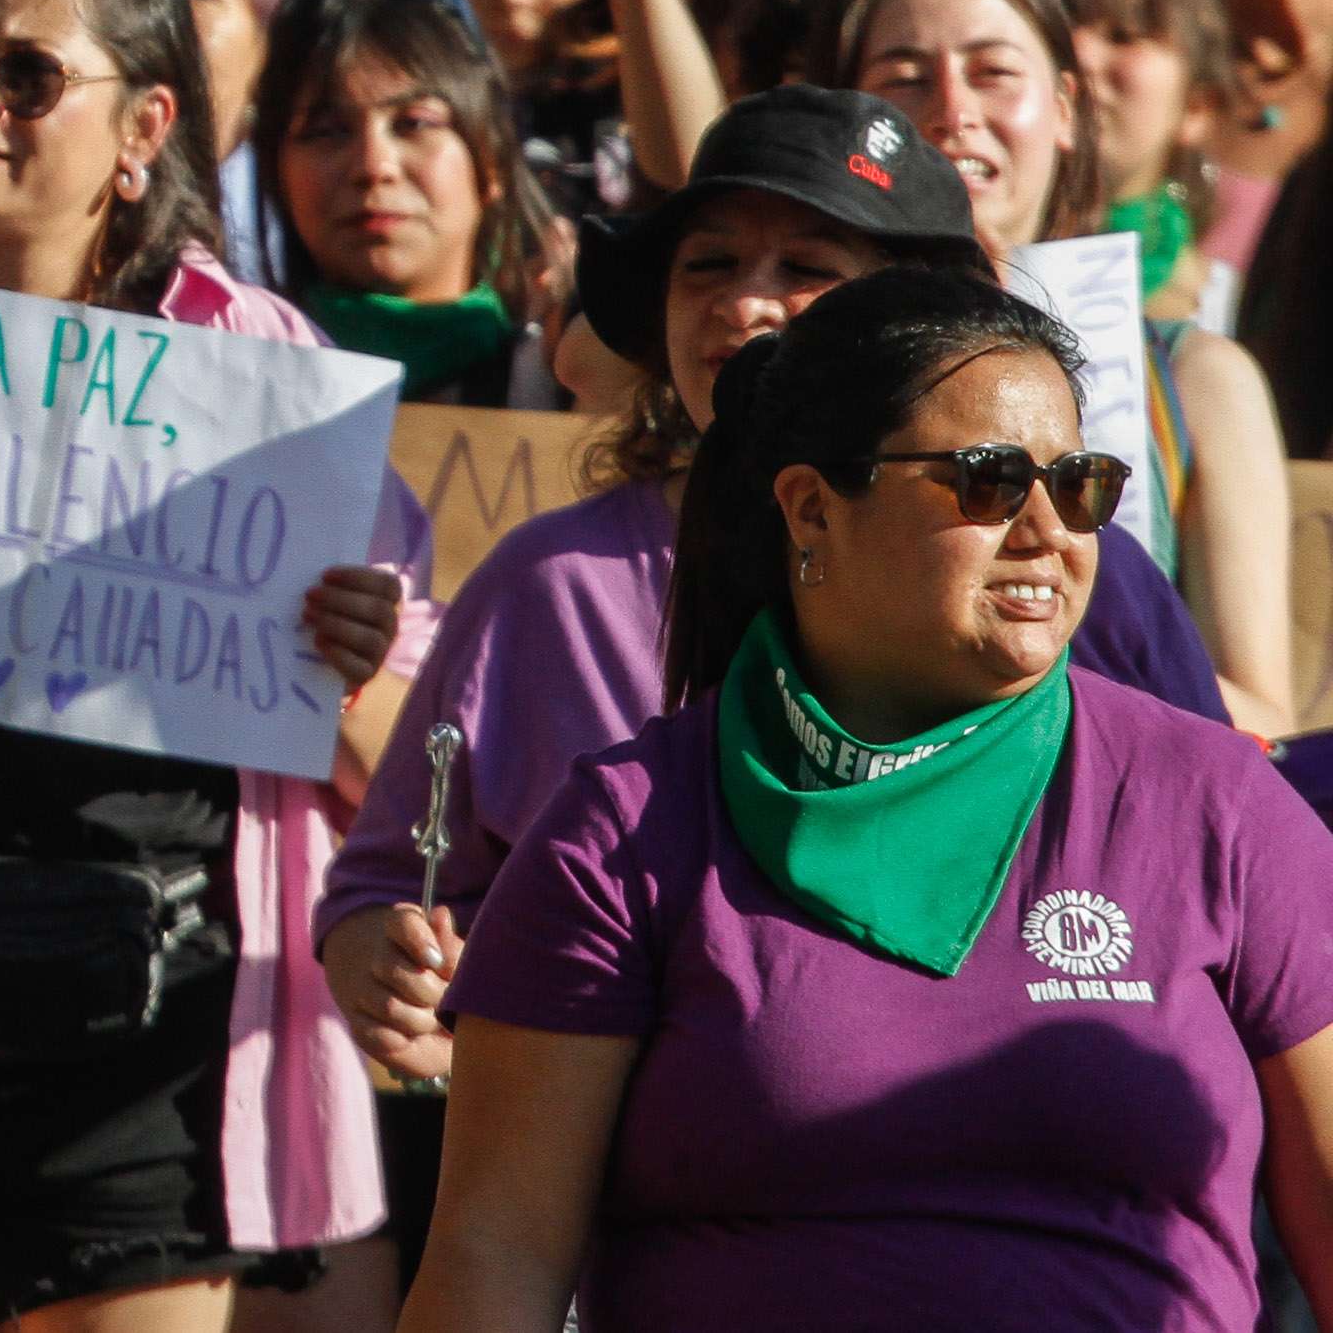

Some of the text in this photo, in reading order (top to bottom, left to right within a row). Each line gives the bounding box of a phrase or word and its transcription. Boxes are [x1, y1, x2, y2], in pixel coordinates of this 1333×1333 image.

[848, 153, 892, 192] Cuba
[42, 316, 178, 448] PAZ,
[1059, 913, 1101, 952] 8M
[1025, 978, 1156, 1003] VIÑA DEL MAR
